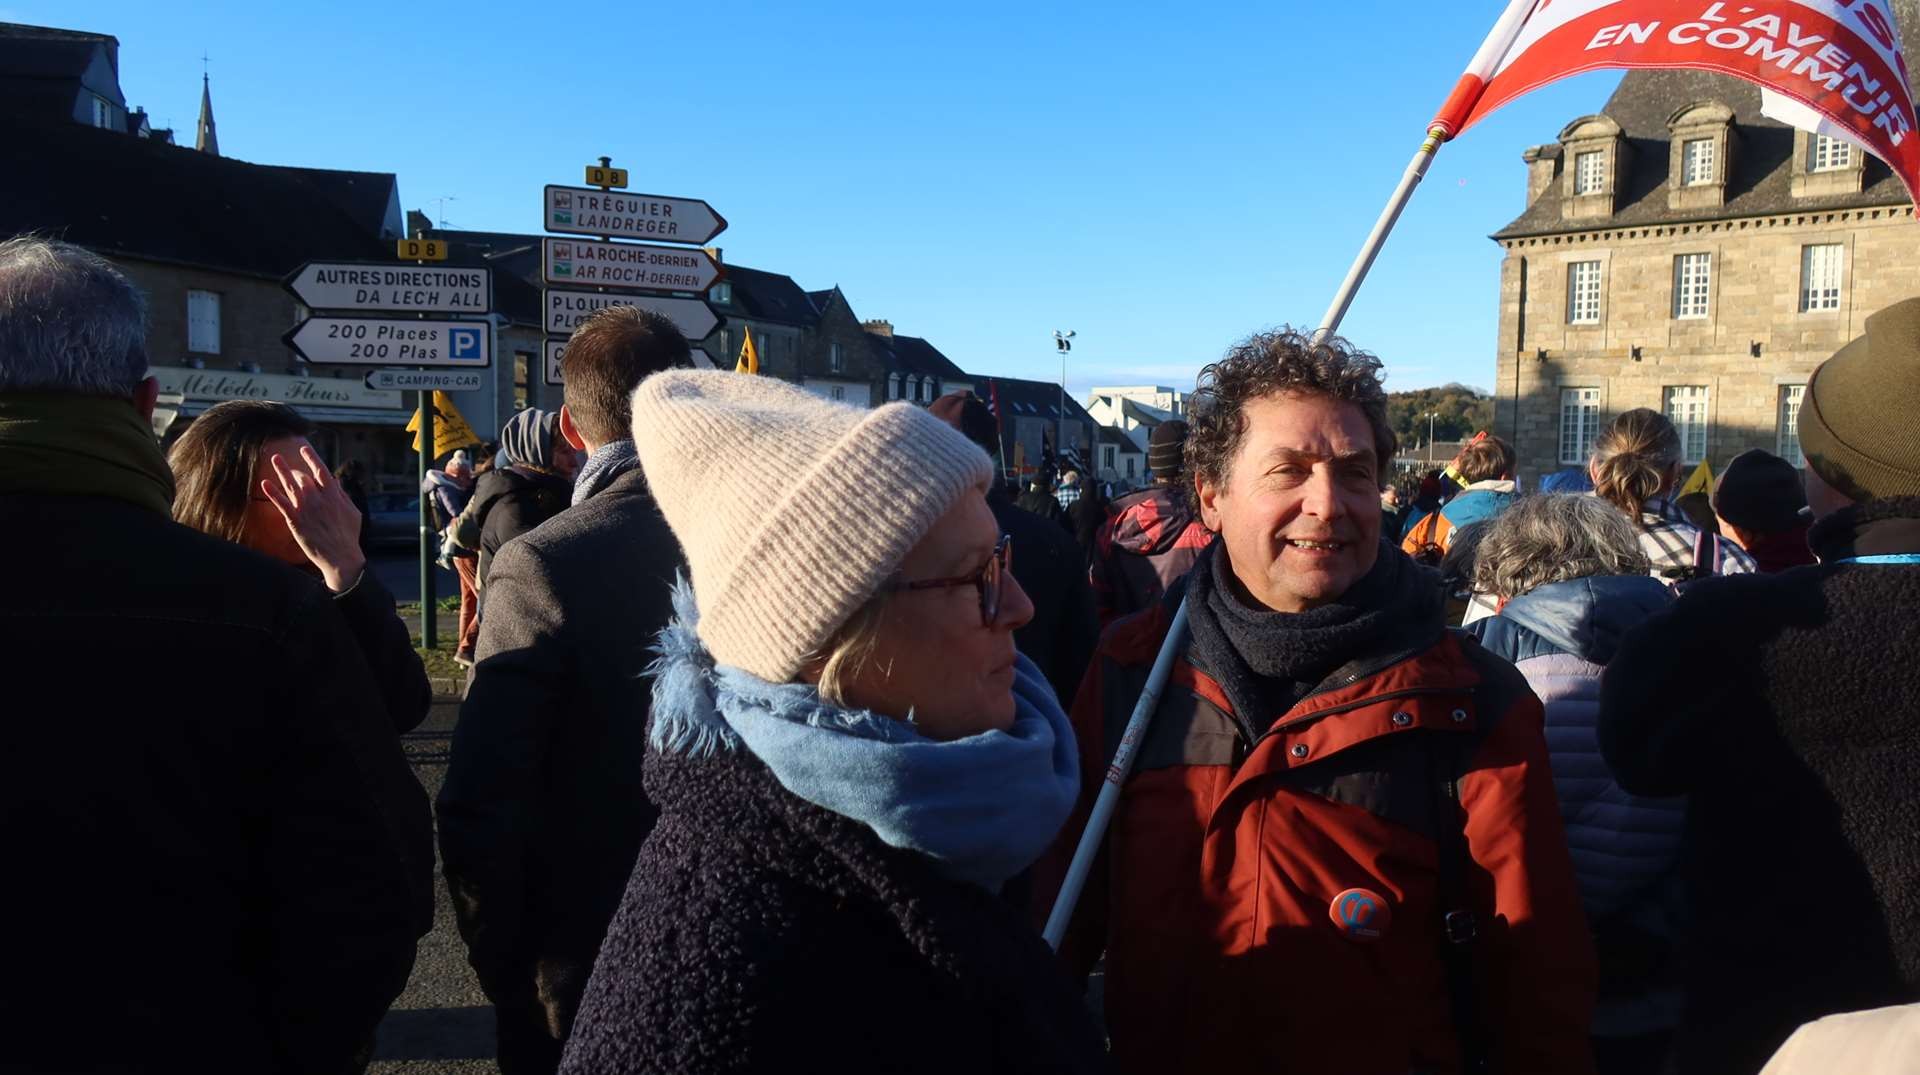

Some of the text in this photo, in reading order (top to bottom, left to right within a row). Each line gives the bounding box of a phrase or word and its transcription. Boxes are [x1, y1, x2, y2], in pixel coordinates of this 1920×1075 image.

[1700, 2, 1910, 137] L'AVENIR
[1584, 21, 1661, 50] EN
[1667, 22, 1904, 147] COMMUN
[594, 169, 619, 184] D 8
[577, 195, 673, 217] TRÉGUIER
[577, 213, 678, 235] LANDREGER
[408, 242, 436, 257] D 8
[576, 245, 699, 268] LA ROCHE-DERRIEN
[316, 269, 482, 288] AUTRES DIRECTIONS
[575, 265, 700, 287] AR ROC'H-DERRIEN
[355, 289, 482, 307] DA LEC'H ALL
[328, 324, 475, 356] 200 Places P
[350, 343, 438, 360] 200 Plas
[285, 381, 350, 401] Fleurs
[396, 374, 479, 387] CAMPING-CAR
